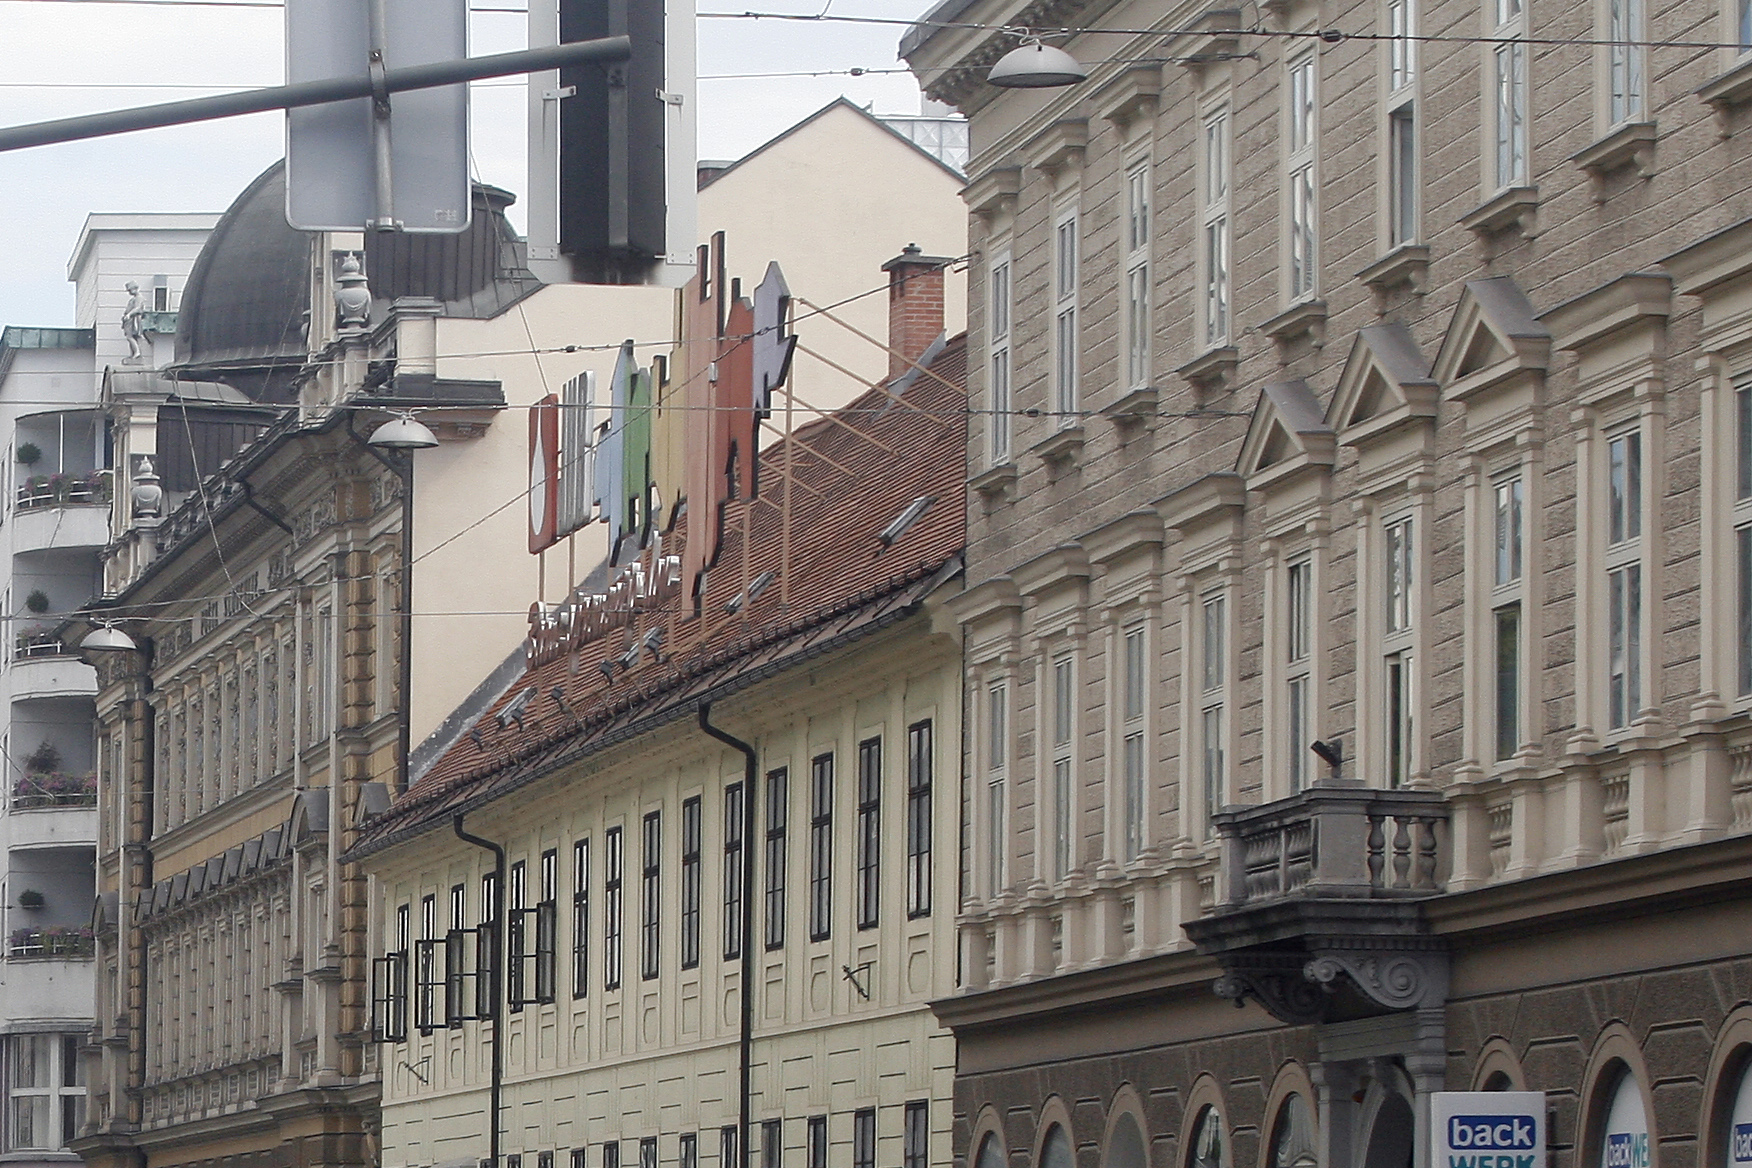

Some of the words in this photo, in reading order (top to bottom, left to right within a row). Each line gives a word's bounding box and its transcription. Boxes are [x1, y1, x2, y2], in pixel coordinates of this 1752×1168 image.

[1453, 1118, 1533, 1146] back
[1609, 1134, 1630, 1168] back
[1631, 1133, 1650, 1168] WE
